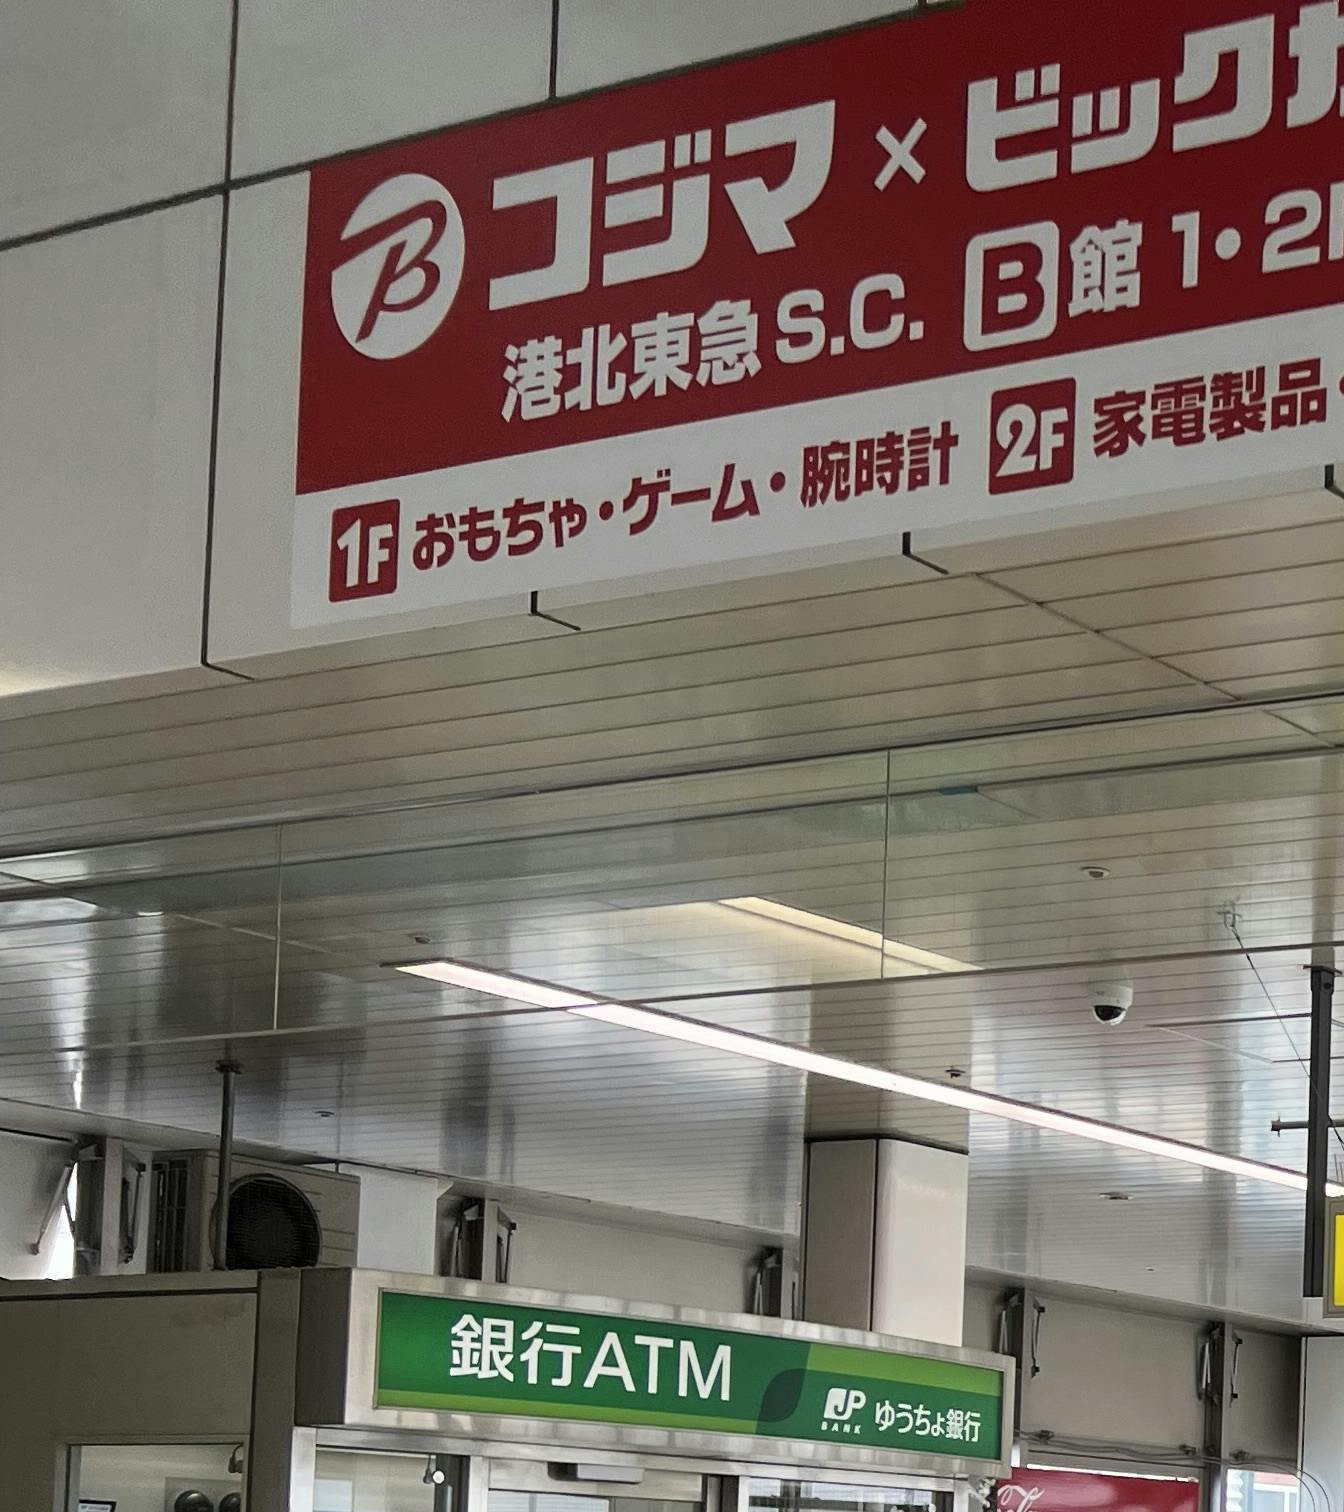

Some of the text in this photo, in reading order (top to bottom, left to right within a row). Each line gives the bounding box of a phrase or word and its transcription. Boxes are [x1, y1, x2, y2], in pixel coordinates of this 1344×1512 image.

[488, 99, 836, 311] コジマ
[336, 516, 394, 587] 1F
[994, 401, 1071, 478] 2F
[821, 1421, 862, 1435] BANK
[875, 1400, 982, 1443] ゆうちょ銀行
